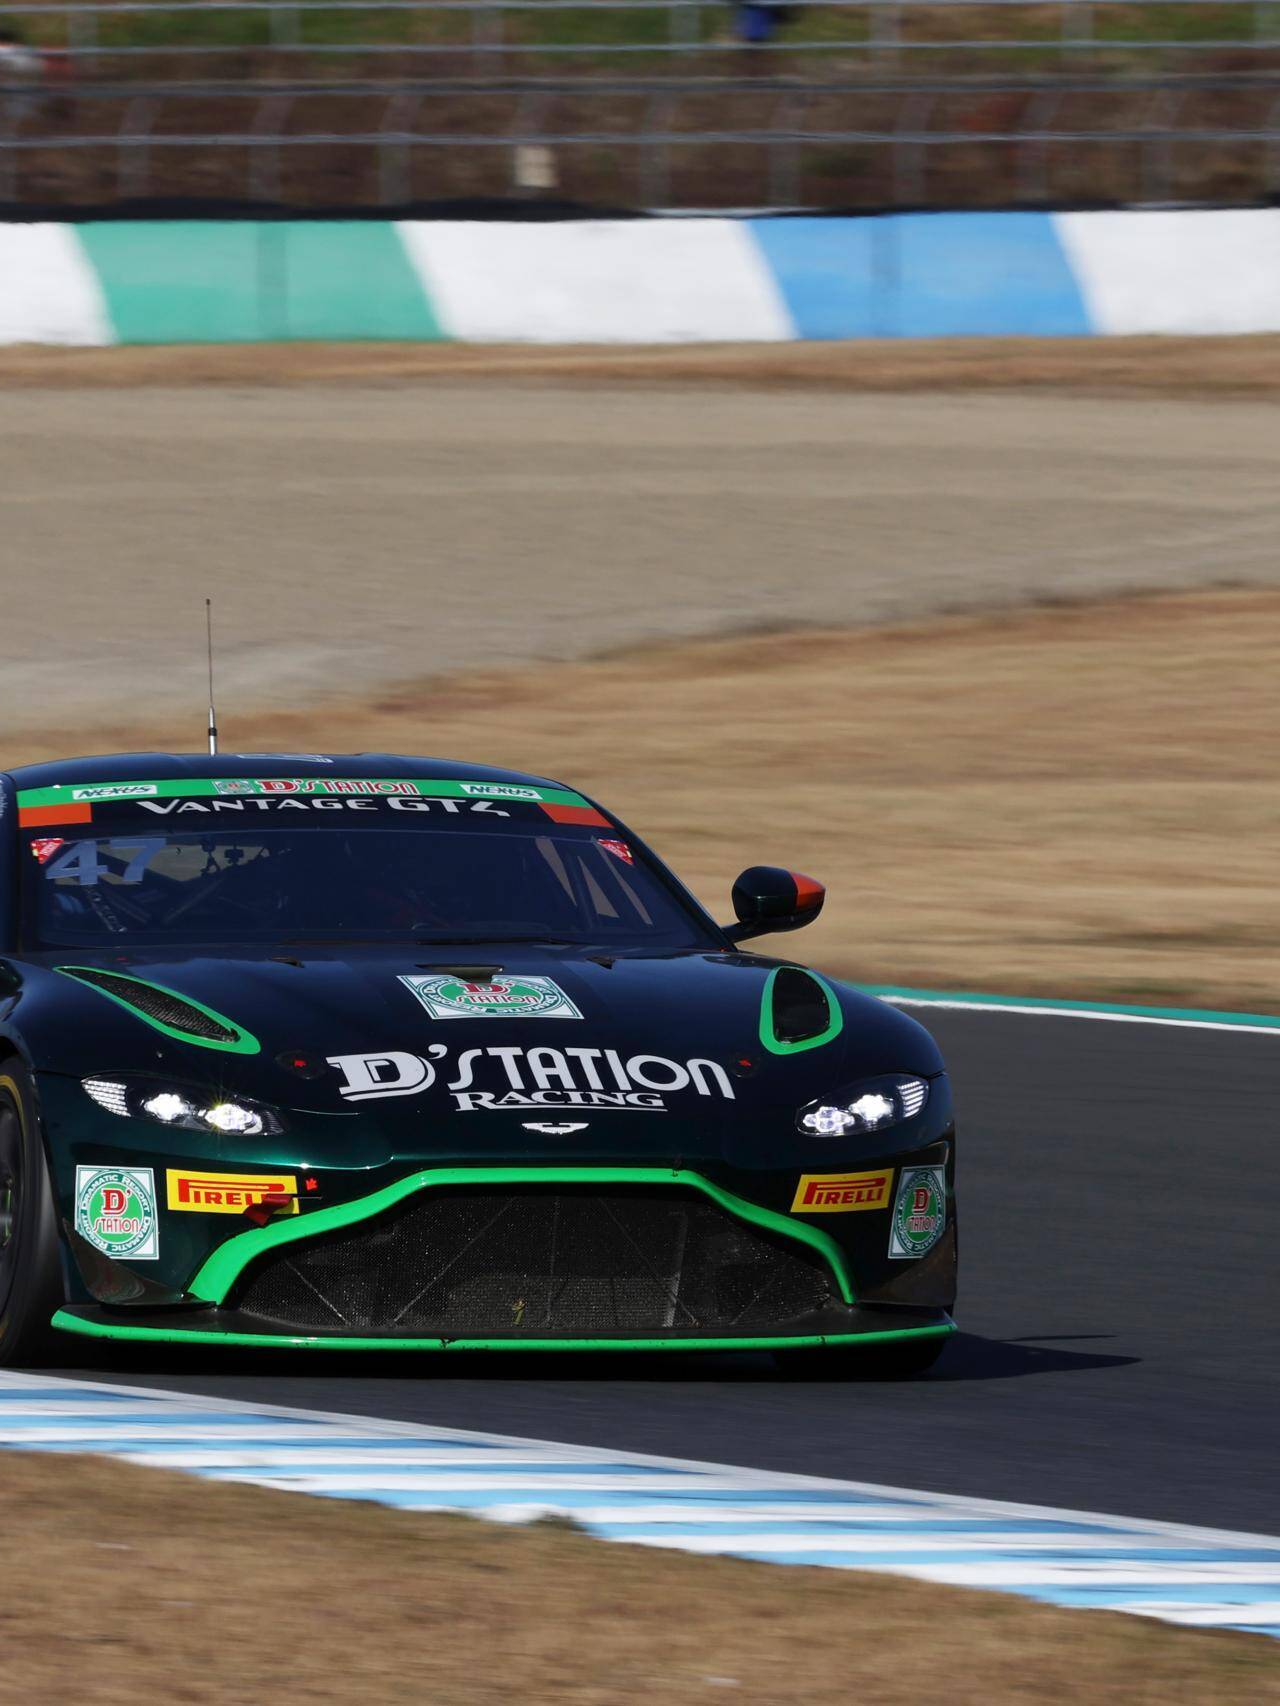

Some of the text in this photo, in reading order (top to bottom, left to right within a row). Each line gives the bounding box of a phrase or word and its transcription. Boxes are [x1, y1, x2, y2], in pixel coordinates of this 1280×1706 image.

[77, 785, 152, 798] NEXUS
[256, 778, 420, 796] D'STATION
[471, 784, 538, 798] NEXUS
[136, 797, 510, 816] VANTAGE GT4
[46, 838, 167, 885] 47
[326, 1044, 736, 1101] D'STATION
[450, 1090, 668, 1112] RACING
[81, 1174, 150, 1213] DRAMATIC RESORT
[102, 1188, 132, 1215] D'
[178, 1179, 285, 1206] PIREL
[803, 1177, 887, 1205] PIRELLI
[93, 1217, 141, 1234] STATION
